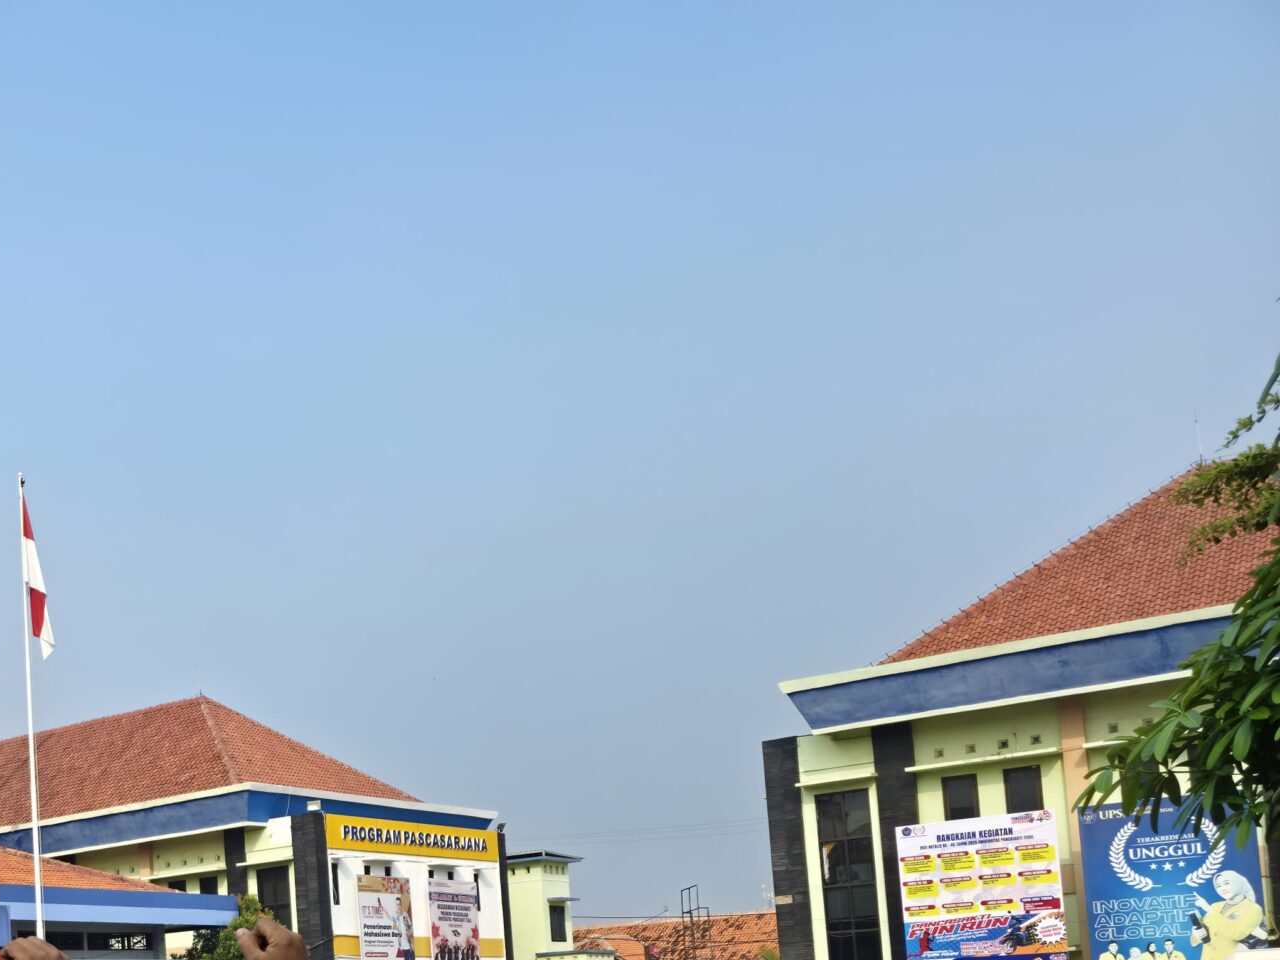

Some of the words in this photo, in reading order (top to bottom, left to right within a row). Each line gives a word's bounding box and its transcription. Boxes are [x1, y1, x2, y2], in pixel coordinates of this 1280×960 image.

[343, 825, 402, 845] PROGRAM
[404, 831, 488, 852] PASCASARJANA
[936, 831, 977, 843] RANGKAIAN
[978, 827, 1014, 839] KEGIATAN
[1136, 832, 1195, 844] TERAKREDIASI
[1128, 842, 1207, 861] UNGGUL
[1092, 893, 1198, 914] INOVATIF
[908, 923, 956, 940] FUN
[959, 915, 1011, 933] RUN
[911, 913, 992, 930] PANCASAKTI
[1095, 909, 1197, 929] ADAPTIF
[1095, 924, 1193, 942] GLOBAL
